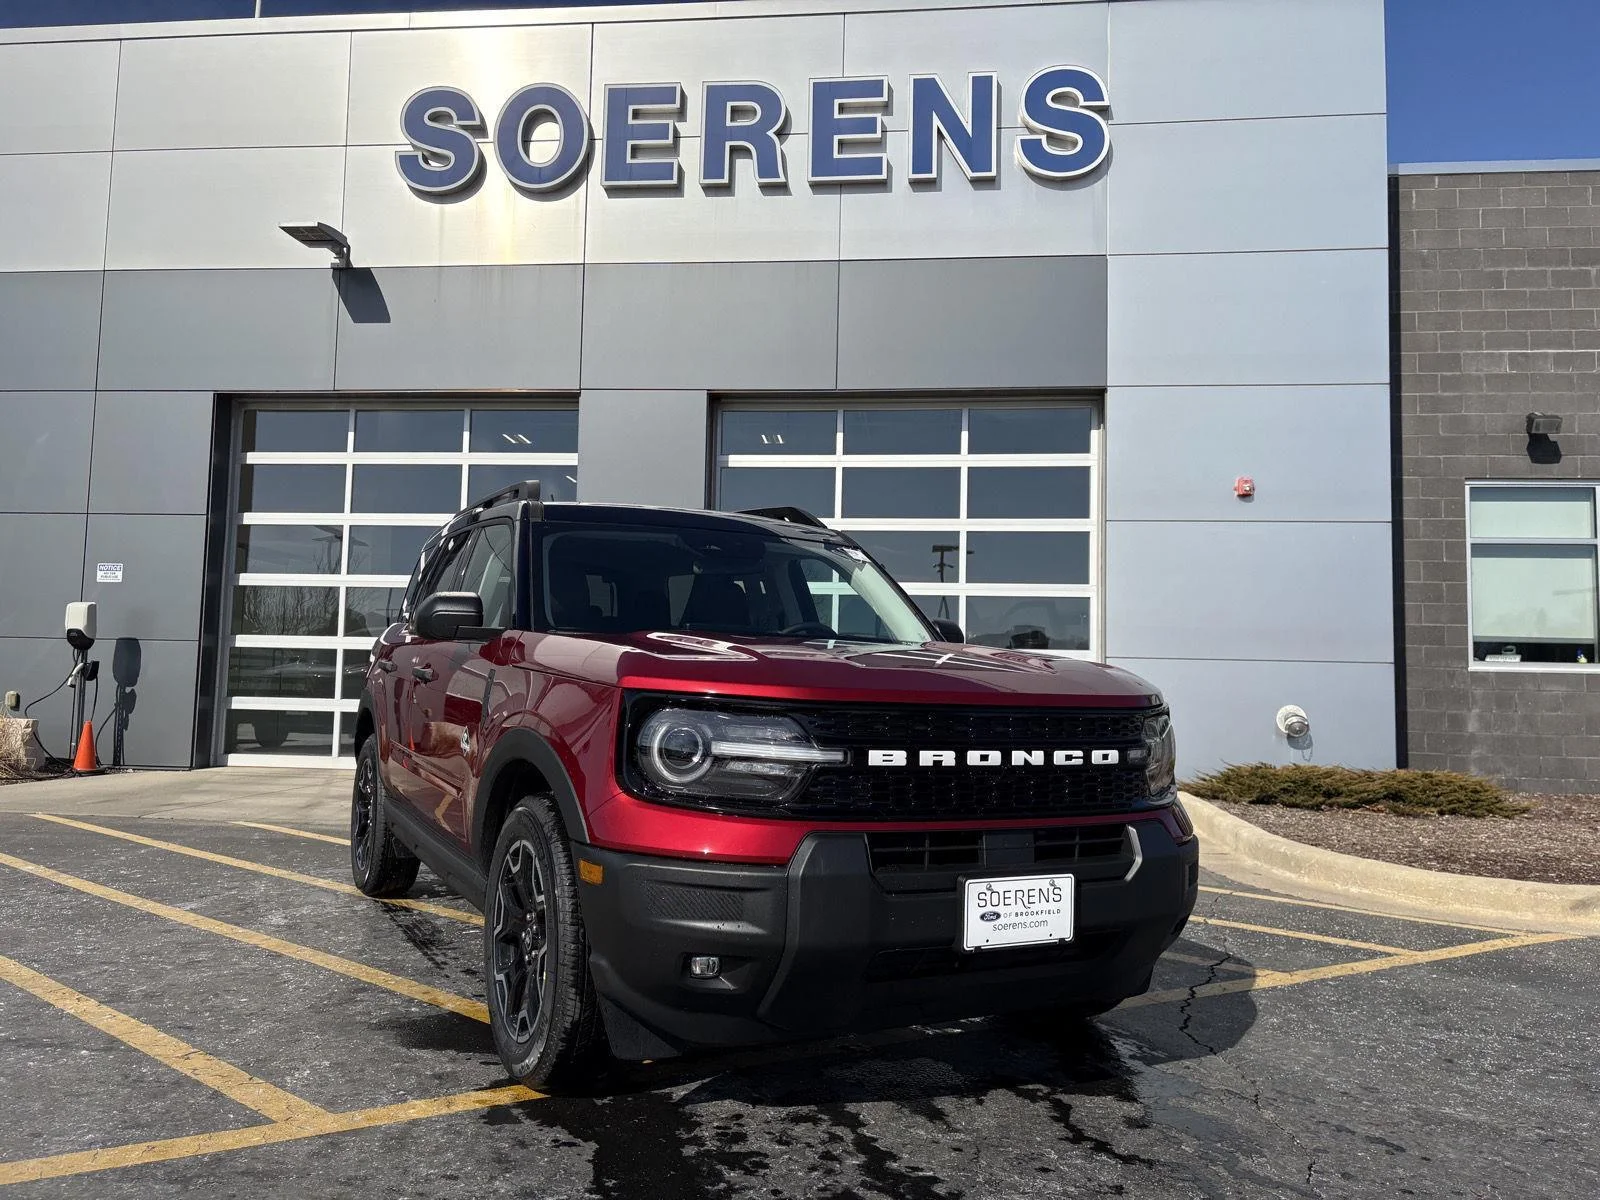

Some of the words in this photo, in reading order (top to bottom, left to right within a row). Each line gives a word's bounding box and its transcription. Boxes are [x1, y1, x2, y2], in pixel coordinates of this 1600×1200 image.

[394, 64, 1110, 193] SOERENS
[868, 749, 1119, 766] BRONCO
[977, 887, 1062, 909] SOERENS
[982, 911, 999, 921] Ford
[1015, 909, 1061, 917] BROOKFIELD
[992, 919, 1049, 931] soerens.com
